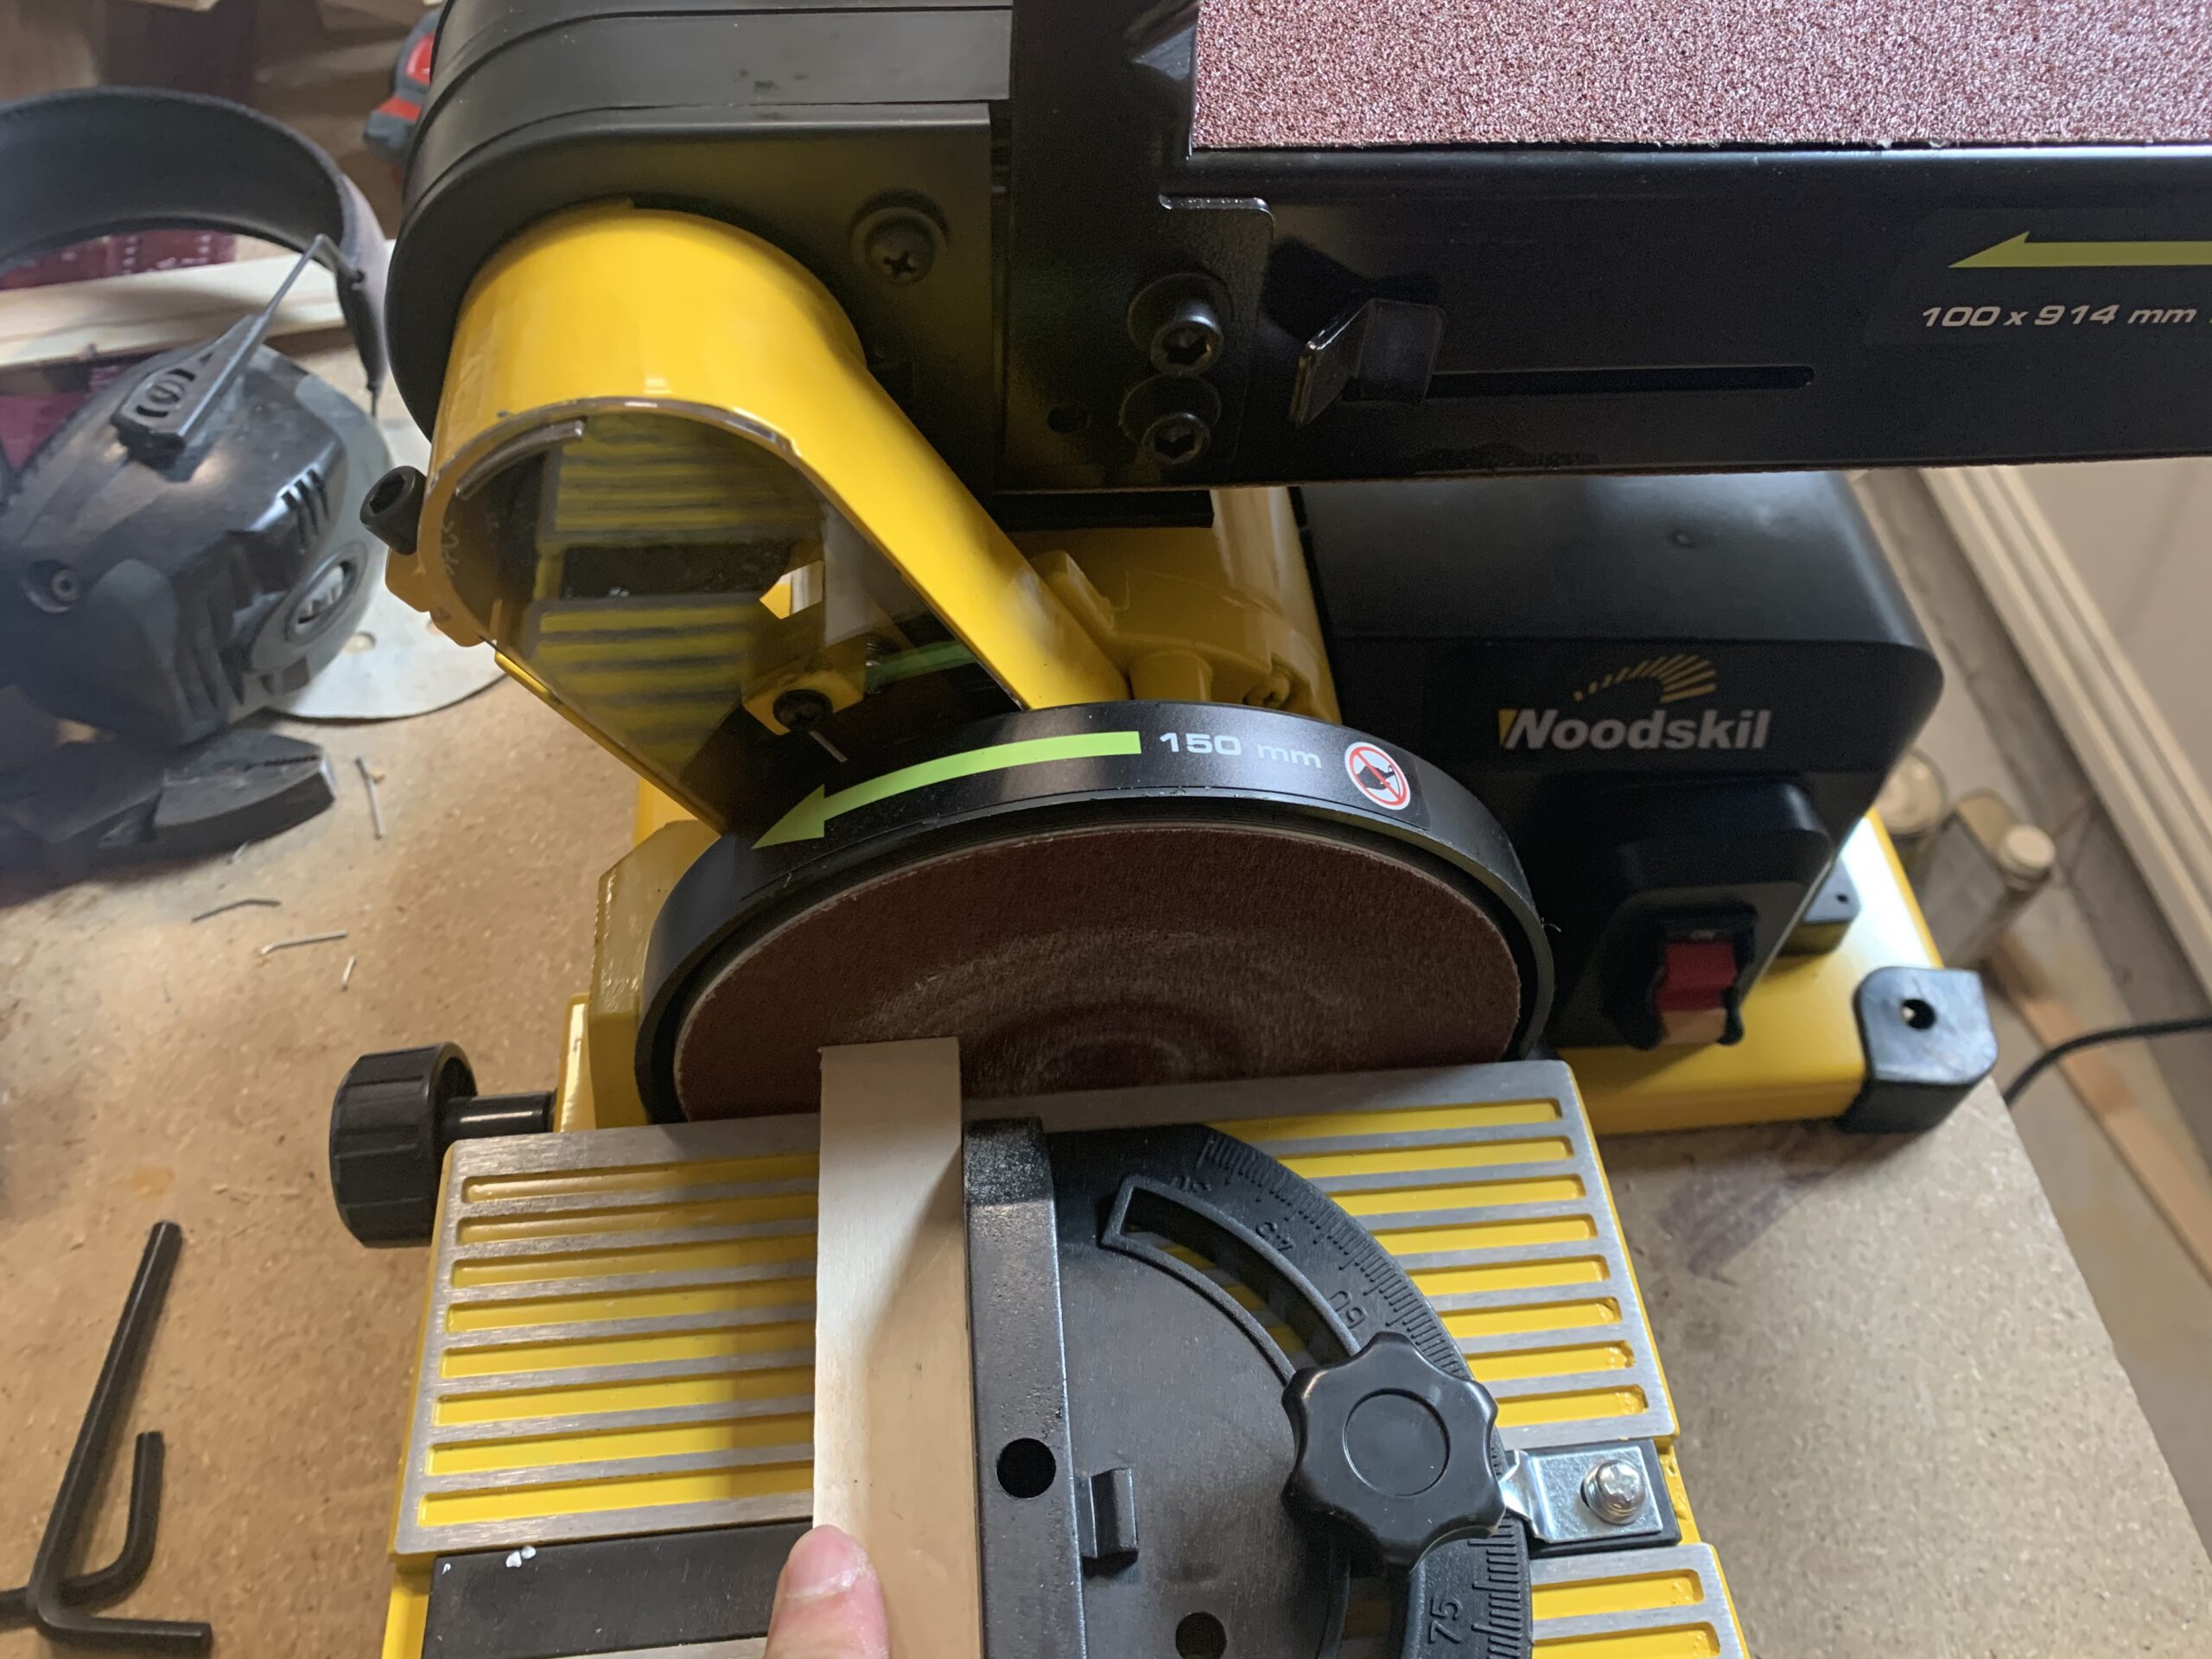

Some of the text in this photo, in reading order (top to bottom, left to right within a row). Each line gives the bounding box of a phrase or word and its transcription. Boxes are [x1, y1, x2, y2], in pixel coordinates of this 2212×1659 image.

[1922, 304, 2197, 327] 100 x 914 mm
[1497, 709, 1772, 750] Woodskil
[1160, 732, 1323, 769] 150 mm
[1327, 1289, 1369, 1332] 60
[1427, 1598, 1464, 1645] 75
